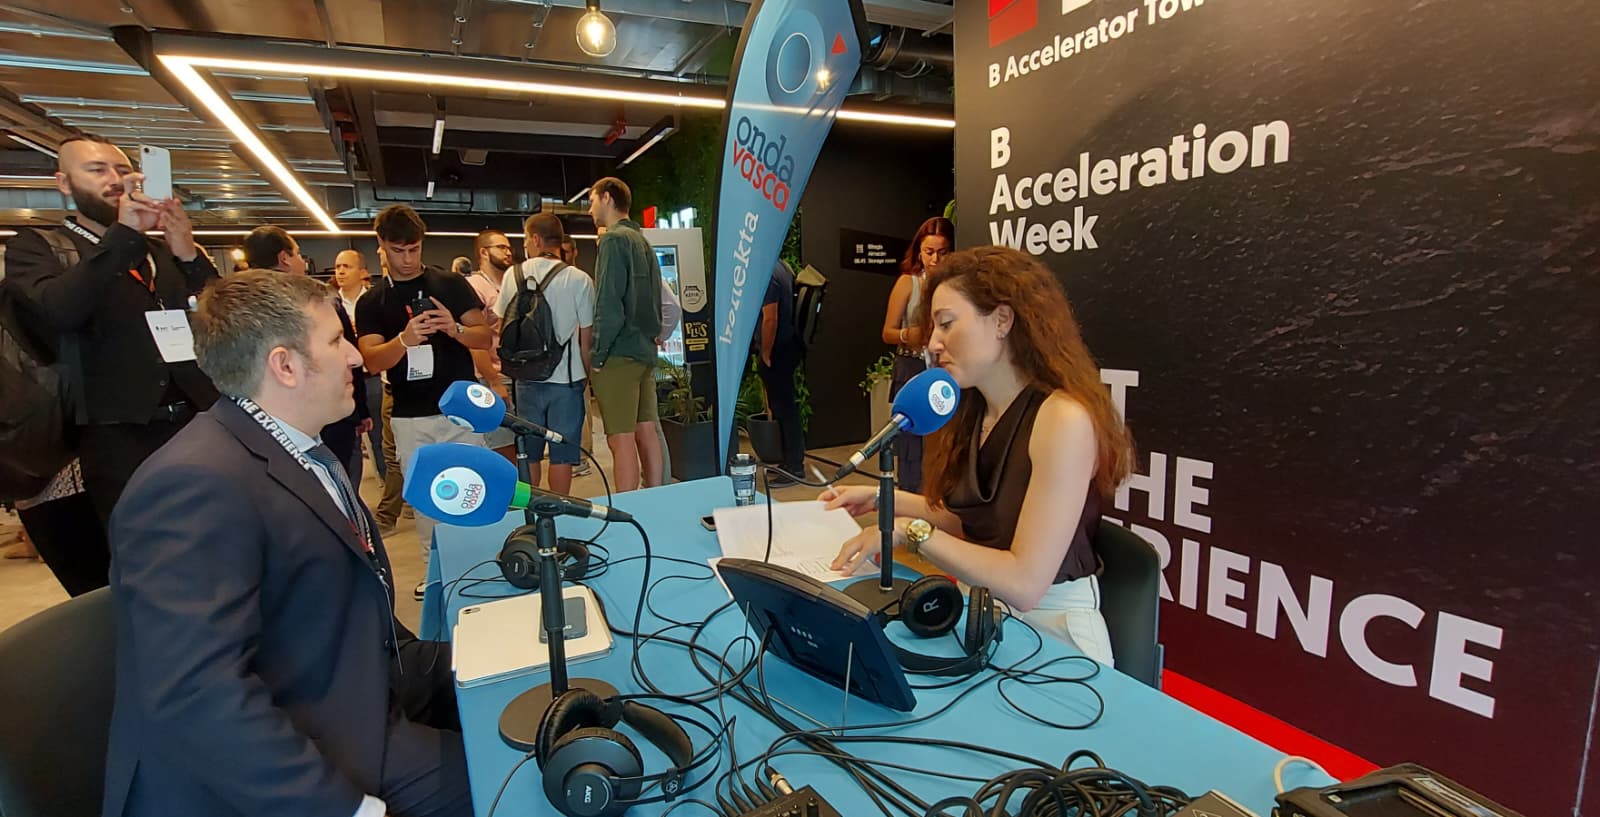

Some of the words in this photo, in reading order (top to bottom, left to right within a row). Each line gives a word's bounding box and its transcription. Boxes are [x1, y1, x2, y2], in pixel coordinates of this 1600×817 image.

[989, 63, 1000, 88] B
[1004, 8, 1139, 82] Accelerator
[733, 139, 791, 212] vasca
[736, 116, 795, 187] onda
[989, 119, 1290, 215] Acceleration
[990, 126, 1011, 169] B
[989, 206, 1099, 256] Week
[461, 483, 476, 509] onda
[1114, 451, 1214, 534] HE
[923, 598, 940, 613] R
[1102, 515, 1503, 719] RIENCE
